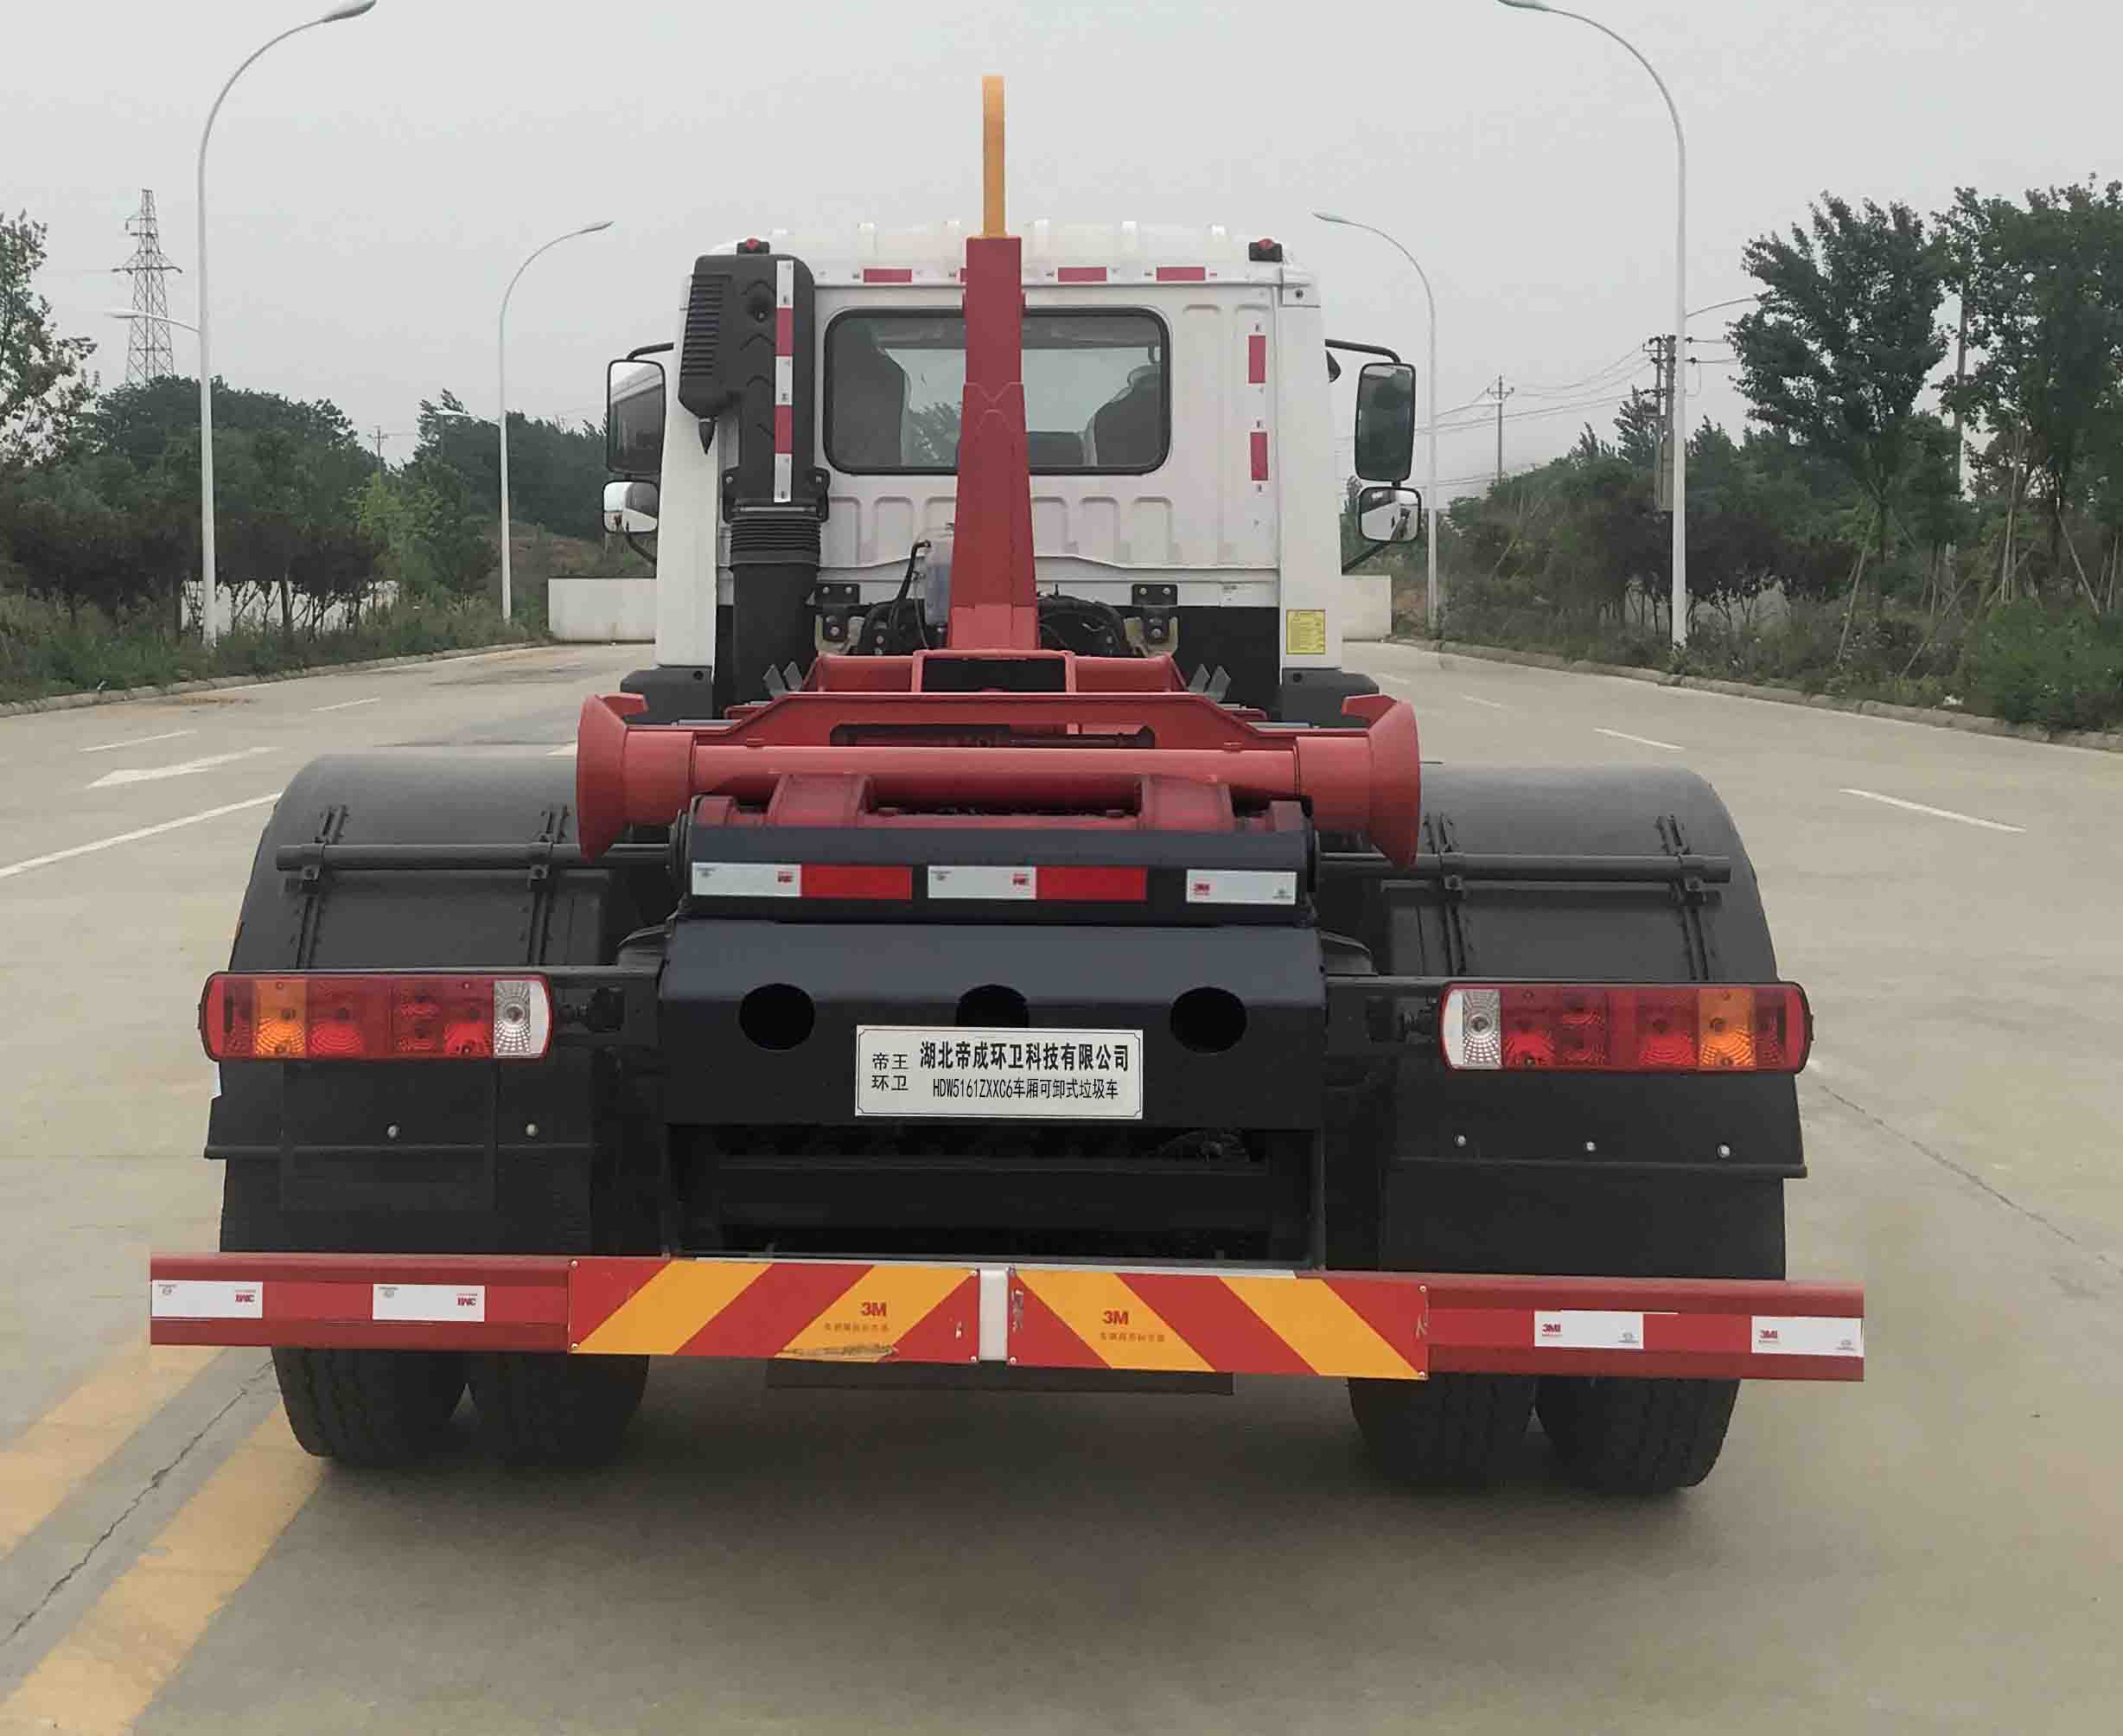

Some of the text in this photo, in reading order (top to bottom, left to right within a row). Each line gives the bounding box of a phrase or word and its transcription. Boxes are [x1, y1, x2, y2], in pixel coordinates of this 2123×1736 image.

[871, 1052, 908, 1070] 帝王
[920, 1041, 1129, 1071] 湖北帝成环卫科技有限公司
[871, 1075, 908, 1092] 环卫
[861, 1302, 887, 1317] 3M
[1101, 1310, 1128, 1324] 3M
